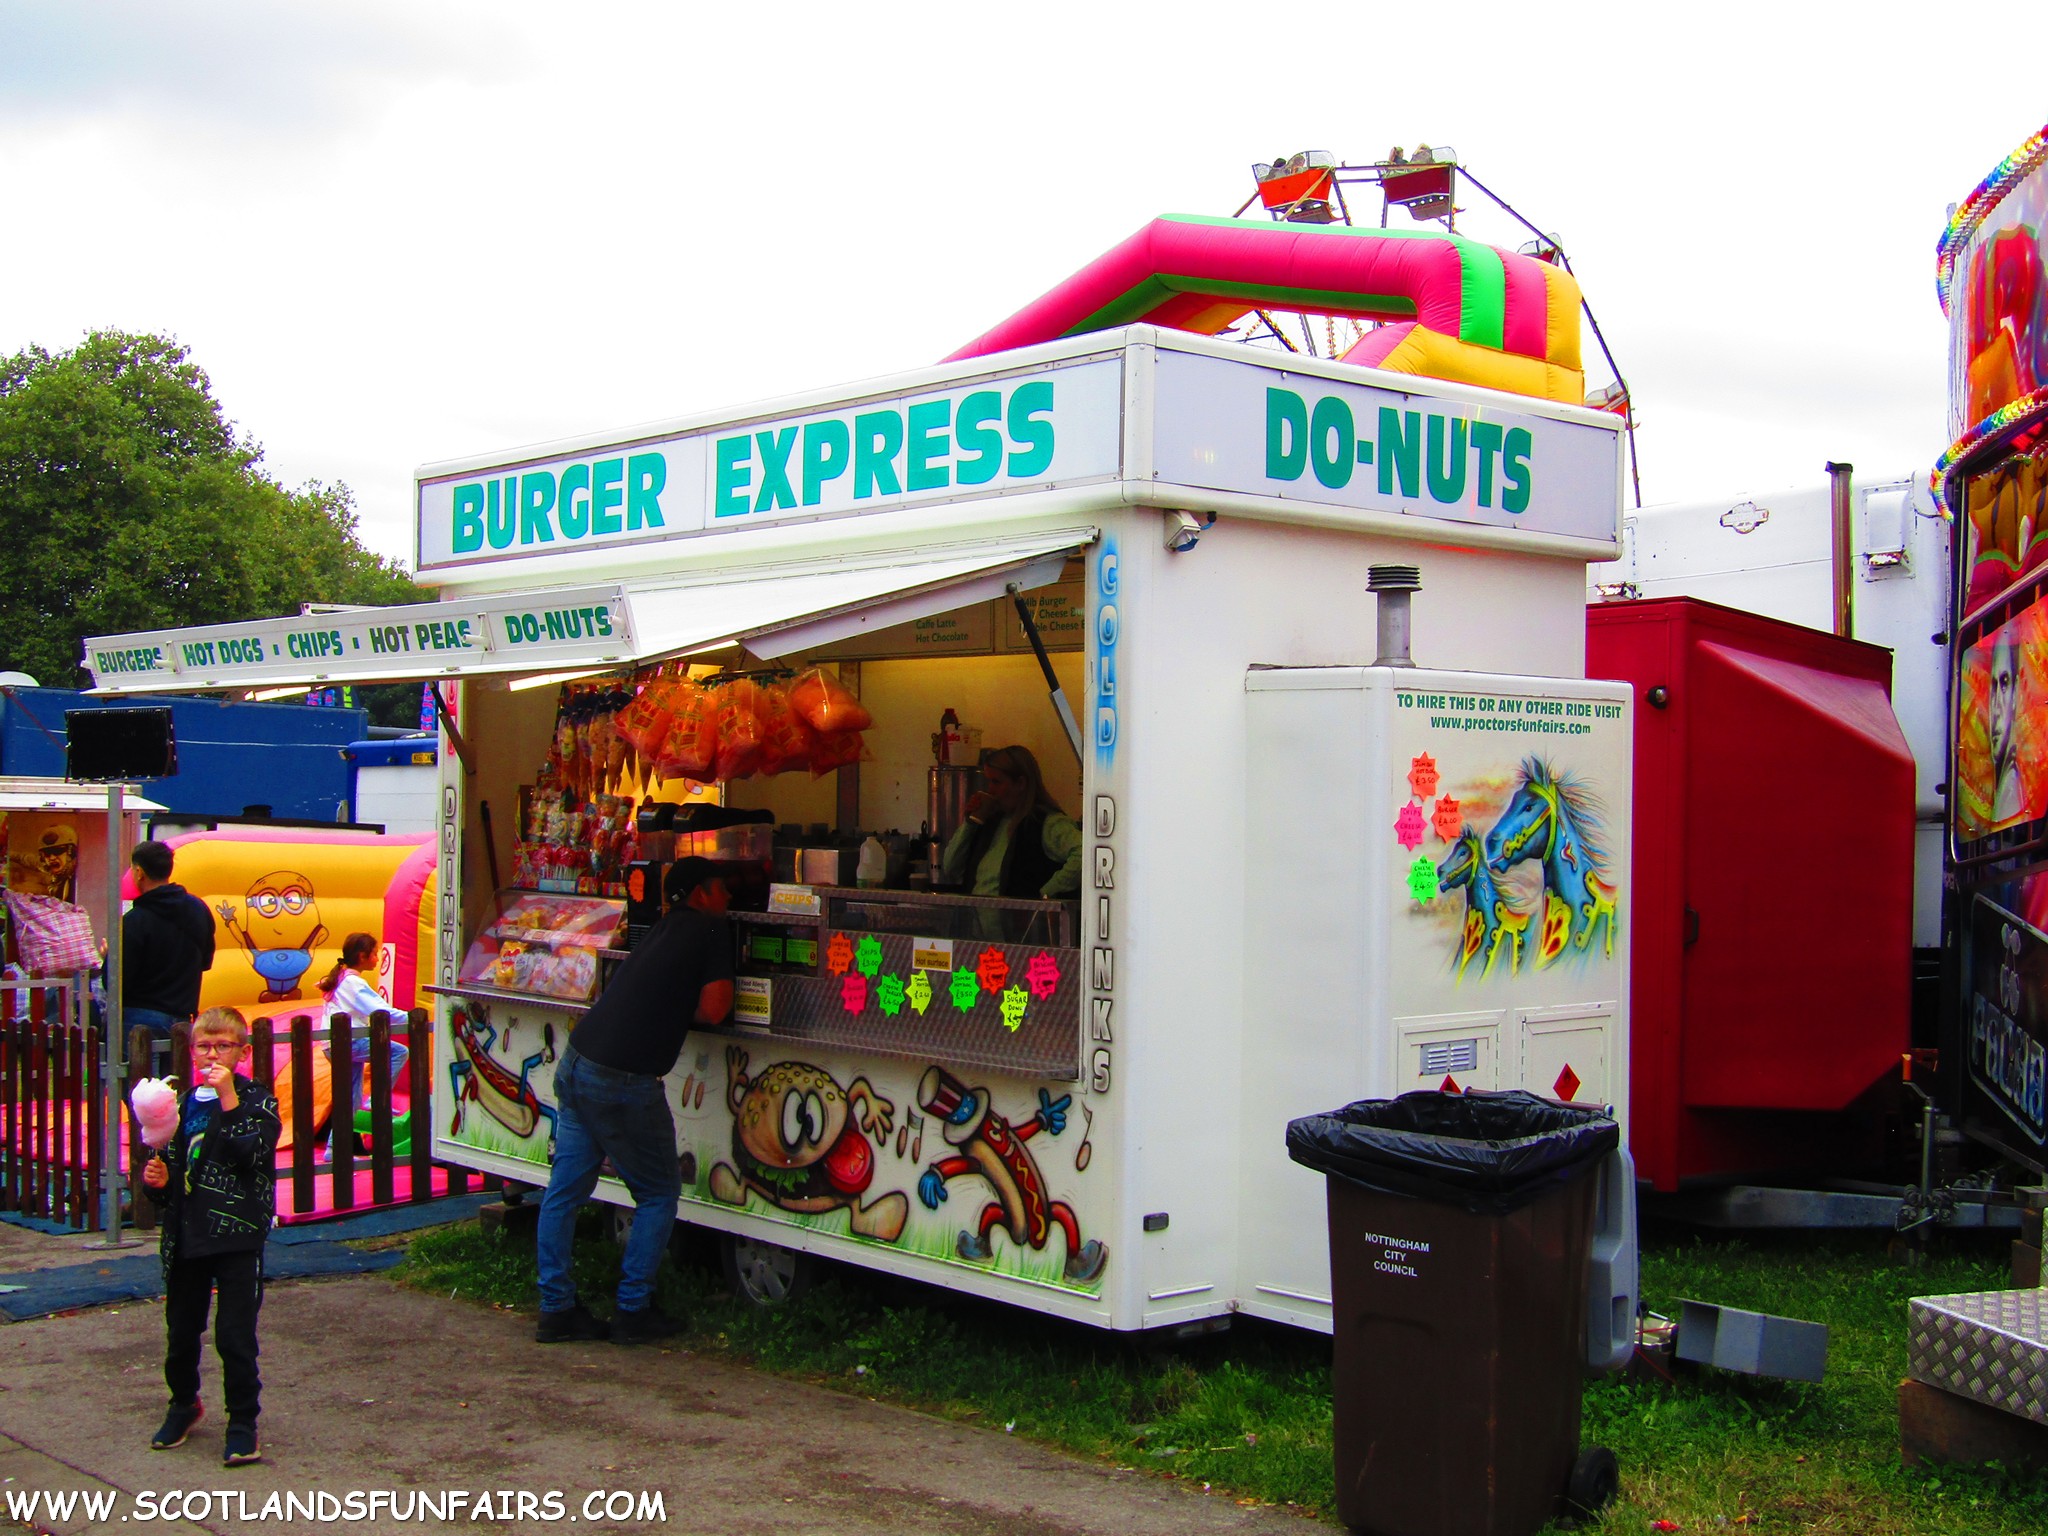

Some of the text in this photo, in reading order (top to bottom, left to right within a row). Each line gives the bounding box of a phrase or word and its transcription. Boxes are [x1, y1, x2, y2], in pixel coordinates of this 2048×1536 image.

[1265, 386, 1532, 514] DO-NUTS
[452, 381, 1054, 554] BURGER EXPRESS
[1040, 596, 1068, 608] Burger
[936, 618, 957, 628] Latte
[1039, 609, 1068, 618] Cheese
[504, 606, 613, 644] DO-NUTS
[1049, 621, 1079, 631] Cheese
[287, 630, 344, 659] CHIPS
[369, 620, 473, 653] HOT PEAS
[916, 632, 969, 643] Hot Chocolate
[97, 647, 164, 673] BURGERS
[182, 637, 264, 666] HOT DOGS
[1098, 554, 1118, 747] COLD
[1396, 694, 1622, 719] TO HIRE THIS OR ANY OTHER RIDE VISIT
[1430, 716, 1591, 735] www.proctorsfunfairs.com
[774, 892, 813, 905] CHIPS
[1092, 795, 1115, 1093] DRINKS
[915, 957, 949, 967] Hot surface
[1007, 995, 1027, 1004] SUGAR
[1365, 1232, 1430, 1252] NOTTINGHAM
[1384, 1250, 1407, 1261] CITY
[1374, 1260, 1418, 1277] COUNCIL
